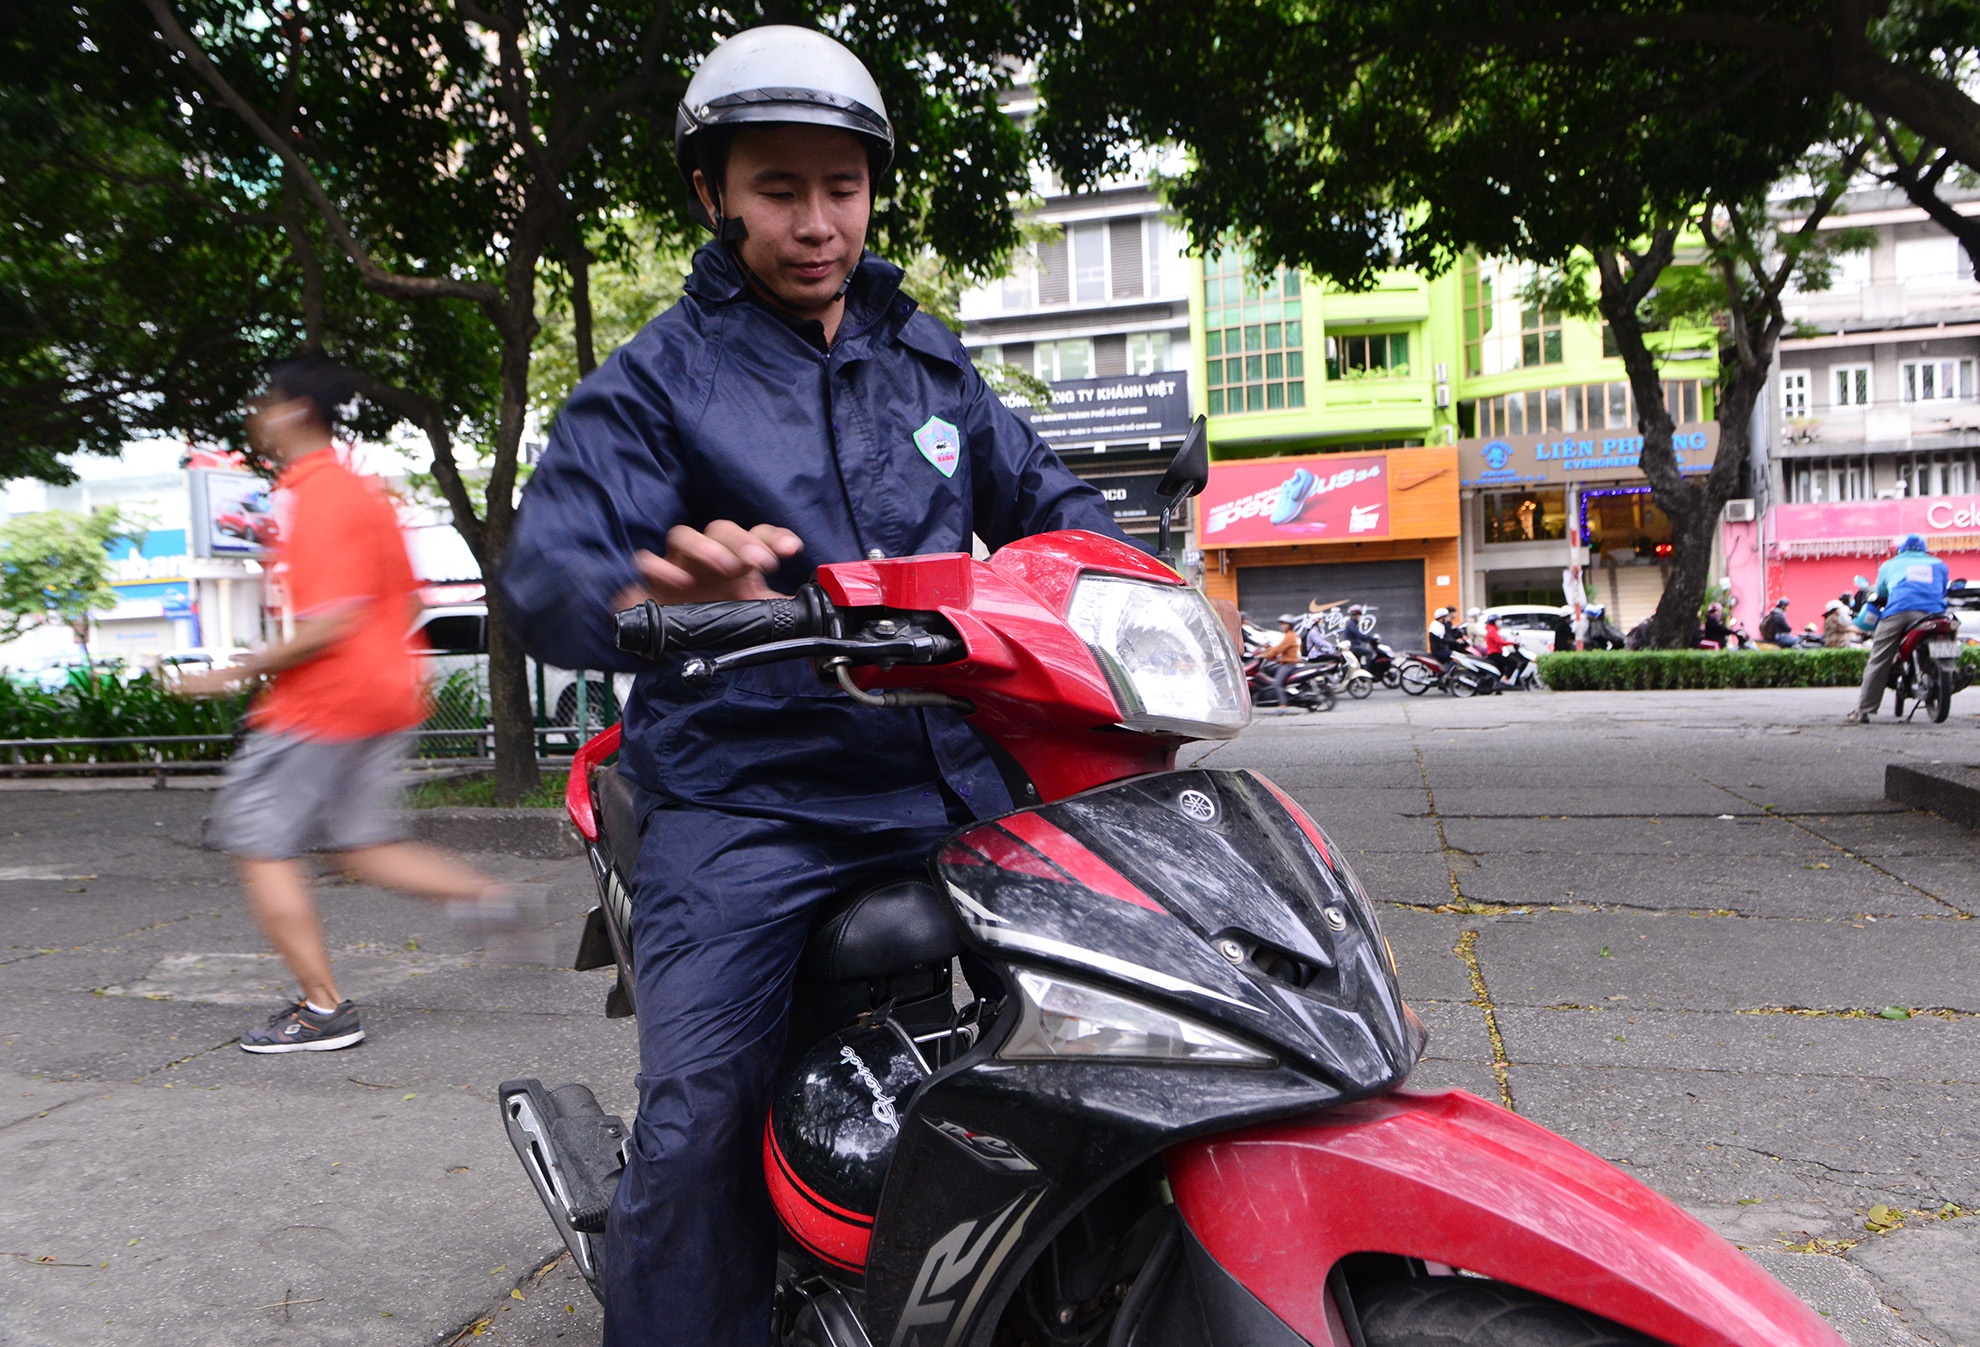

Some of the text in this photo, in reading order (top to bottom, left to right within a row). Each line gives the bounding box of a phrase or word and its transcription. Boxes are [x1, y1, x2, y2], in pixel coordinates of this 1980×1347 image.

[1077, 388, 1094, 402] TY
[1096, 383, 1142, 401] KHÁNH
[1145, 379, 1175, 398] VIỆT
[1536, 437, 1594, 461] LIÊN
[1602, 432, 1707, 457] PHNG
[1926, 501, 1980, 530] Cel
